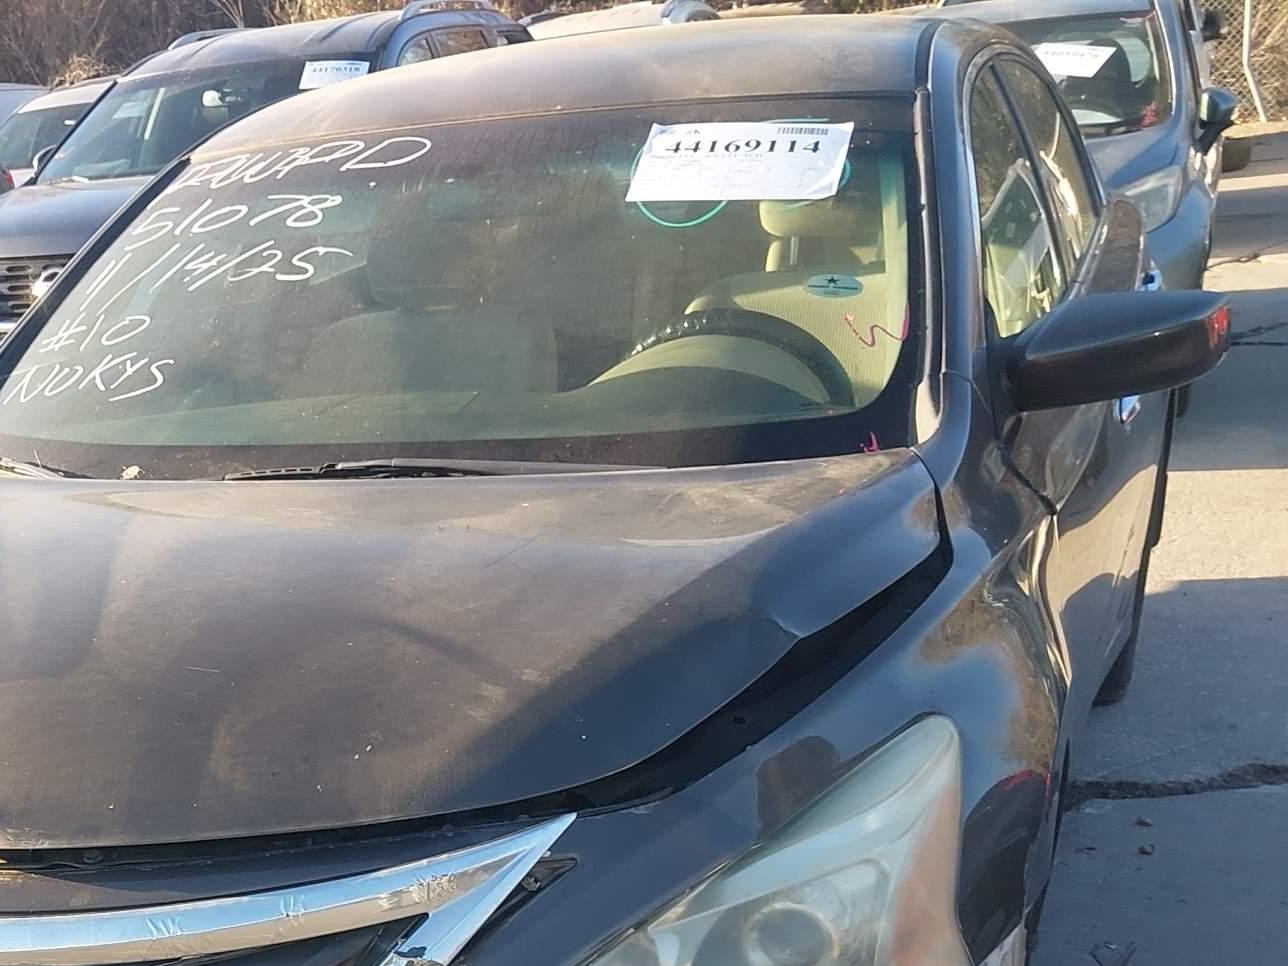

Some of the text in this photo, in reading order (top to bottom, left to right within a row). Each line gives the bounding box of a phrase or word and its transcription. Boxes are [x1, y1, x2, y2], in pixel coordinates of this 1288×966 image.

[665, 139, 822, 154] 44169114
[125, 194, 343, 251] 51078
[39, 312, 152, 352] #10
